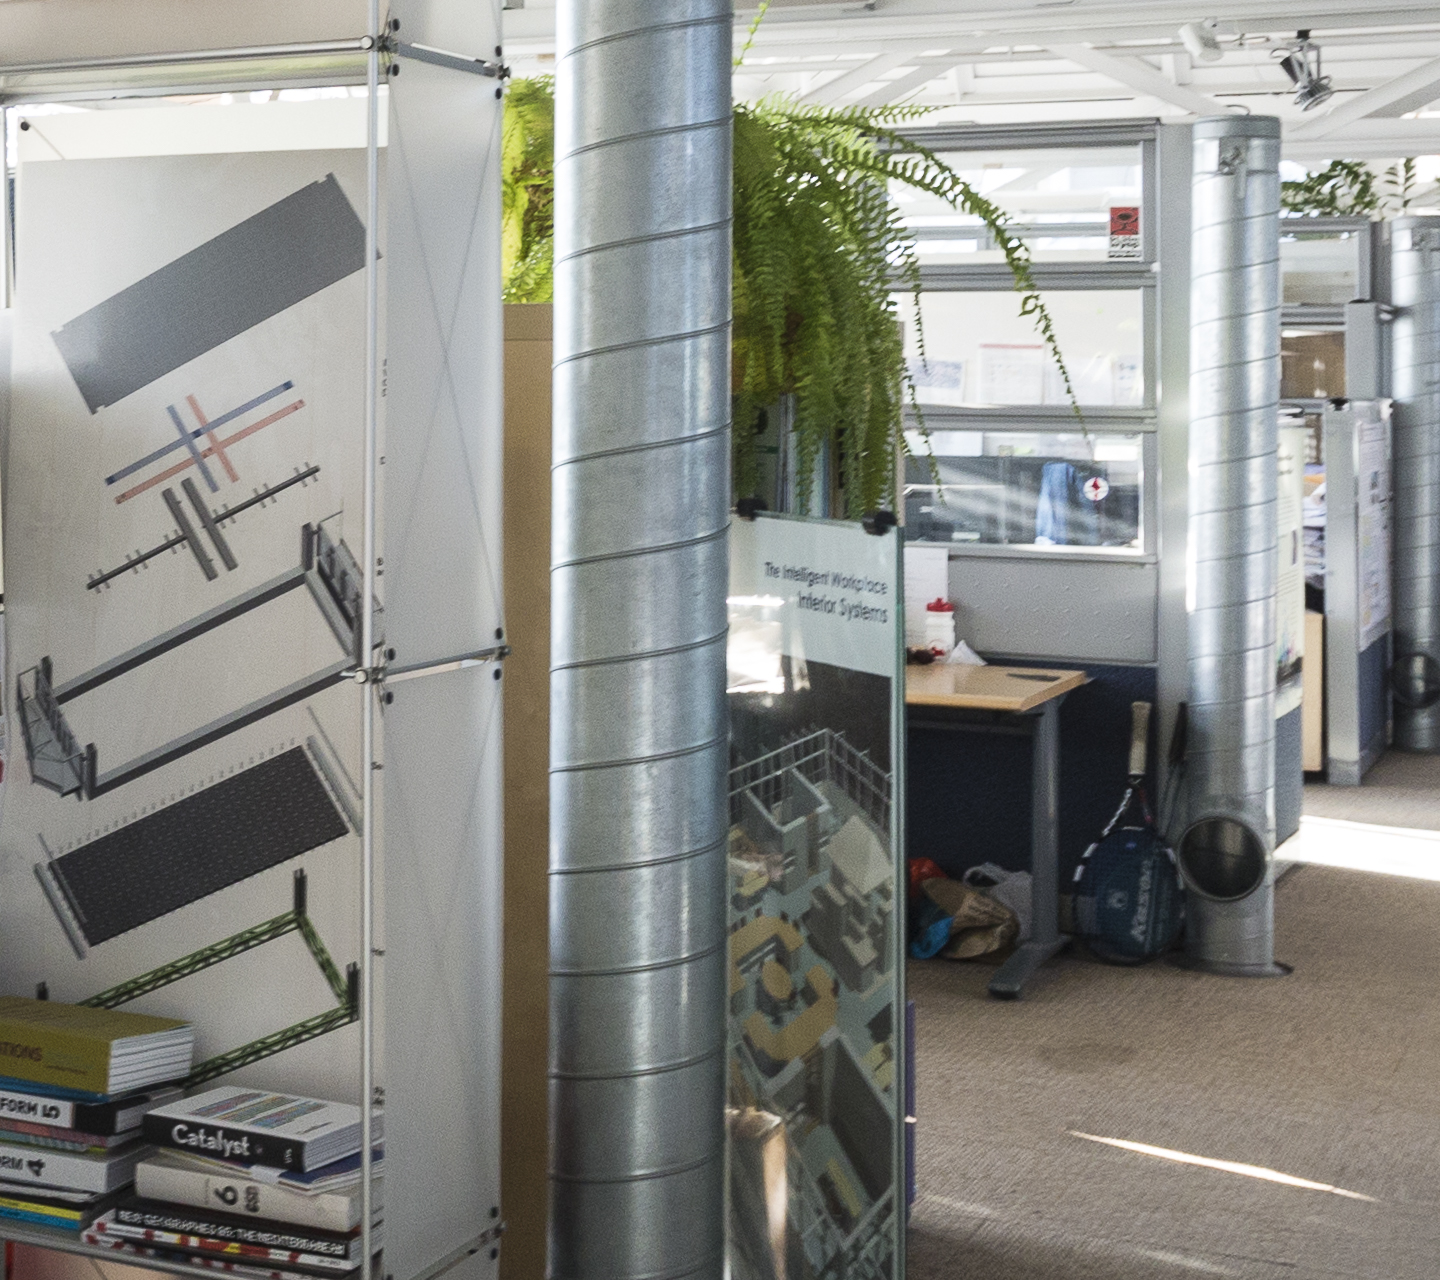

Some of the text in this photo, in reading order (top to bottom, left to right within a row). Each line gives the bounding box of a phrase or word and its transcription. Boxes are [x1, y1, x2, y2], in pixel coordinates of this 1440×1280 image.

[764, 561, 889, 595] The Intelligent Workplace
[798, 590, 889, 624] Interior Systems
[41, 1104, 61, 1120] 5
[171, 1123, 251, 1158] Catalyst
